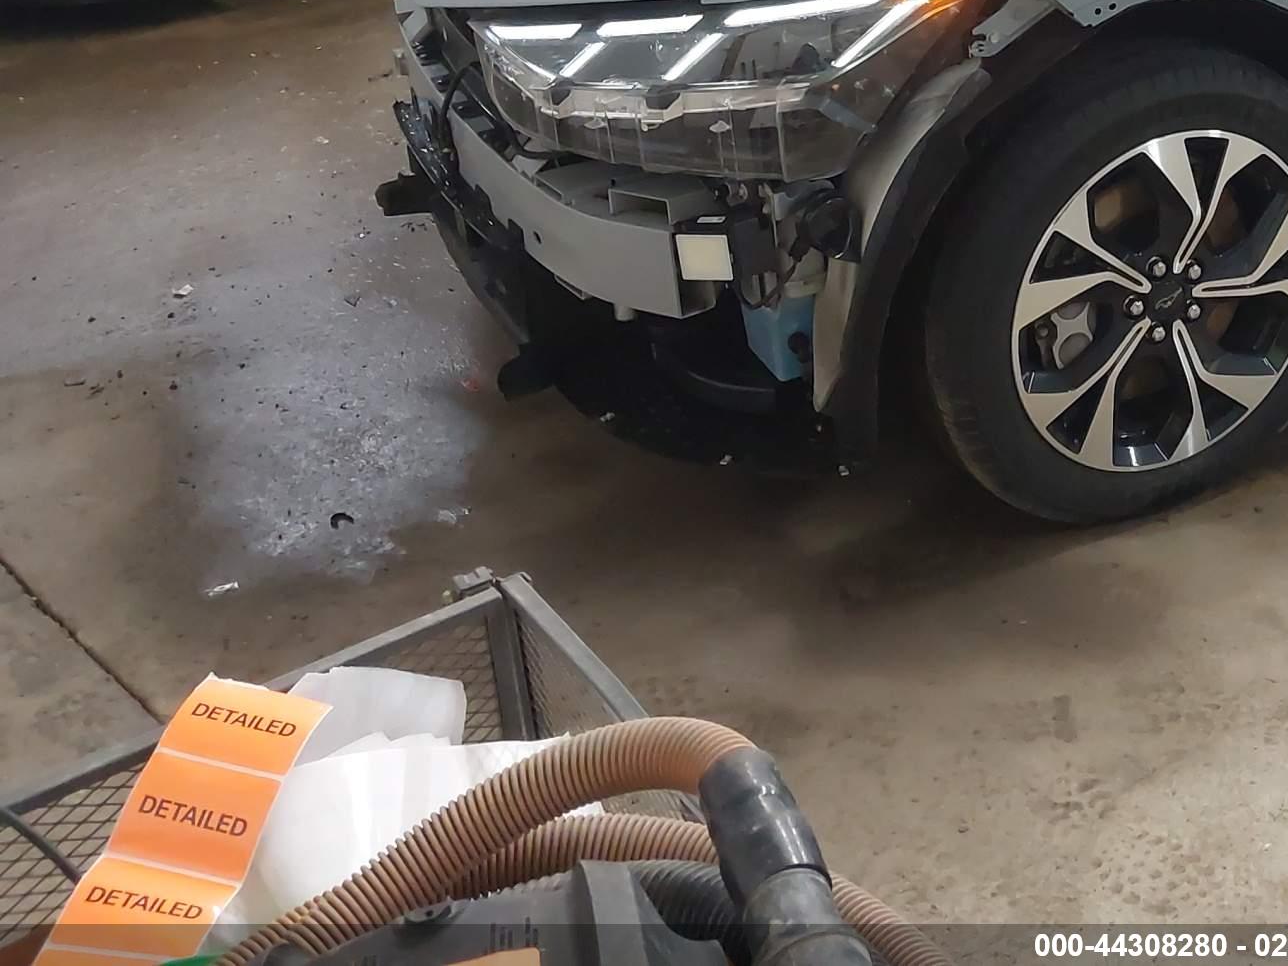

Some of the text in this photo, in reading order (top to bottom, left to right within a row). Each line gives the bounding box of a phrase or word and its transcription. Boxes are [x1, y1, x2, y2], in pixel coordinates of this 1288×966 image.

[191, 702, 297, 737] DETAILED
[138, 794, 248, 837] DETAILED
[85, 886, 203, 920] DETAILED
